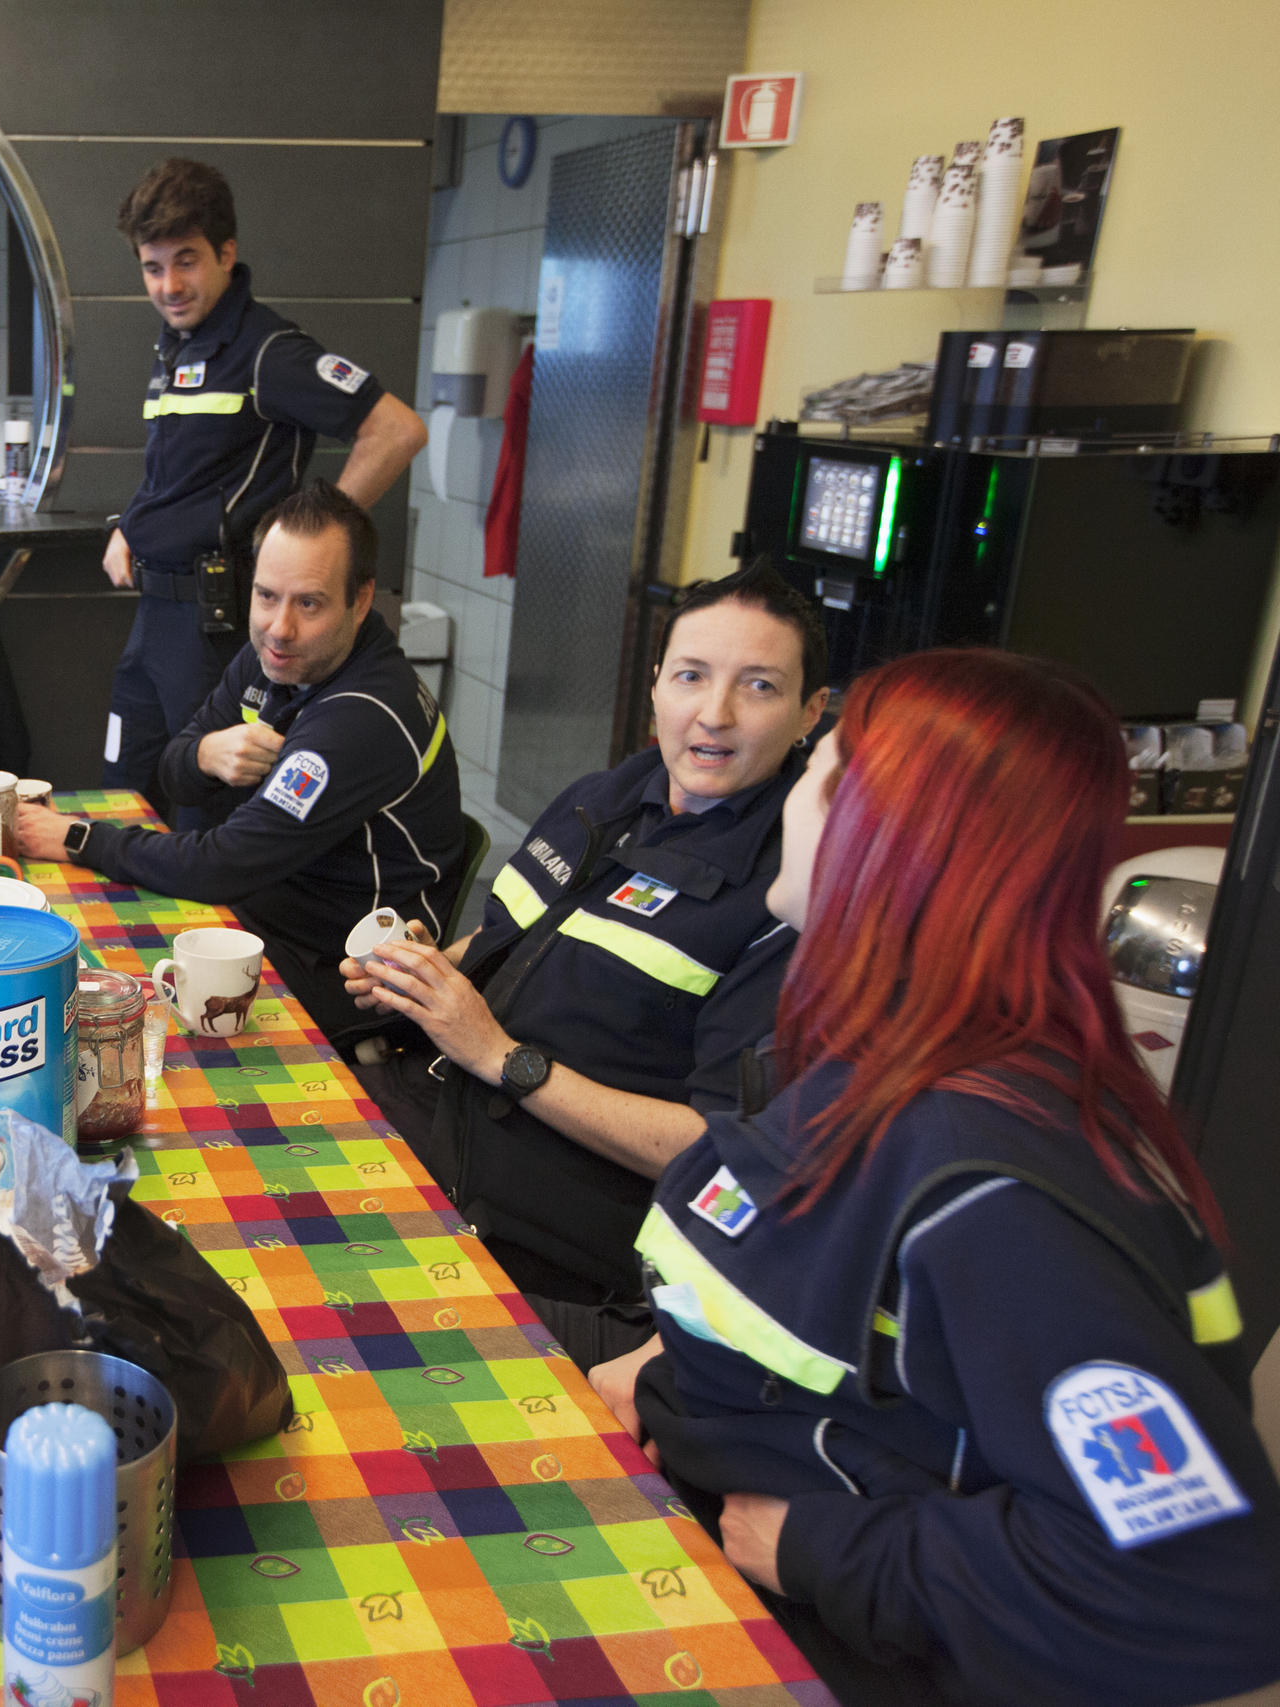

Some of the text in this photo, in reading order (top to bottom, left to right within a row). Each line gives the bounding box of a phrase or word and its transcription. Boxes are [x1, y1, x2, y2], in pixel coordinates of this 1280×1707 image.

[295, 753, 326, 780] FCTSA
[1058, 1376, 1155, 1425] FCTSA
[21, 1579, 76, 1601] Valflora
